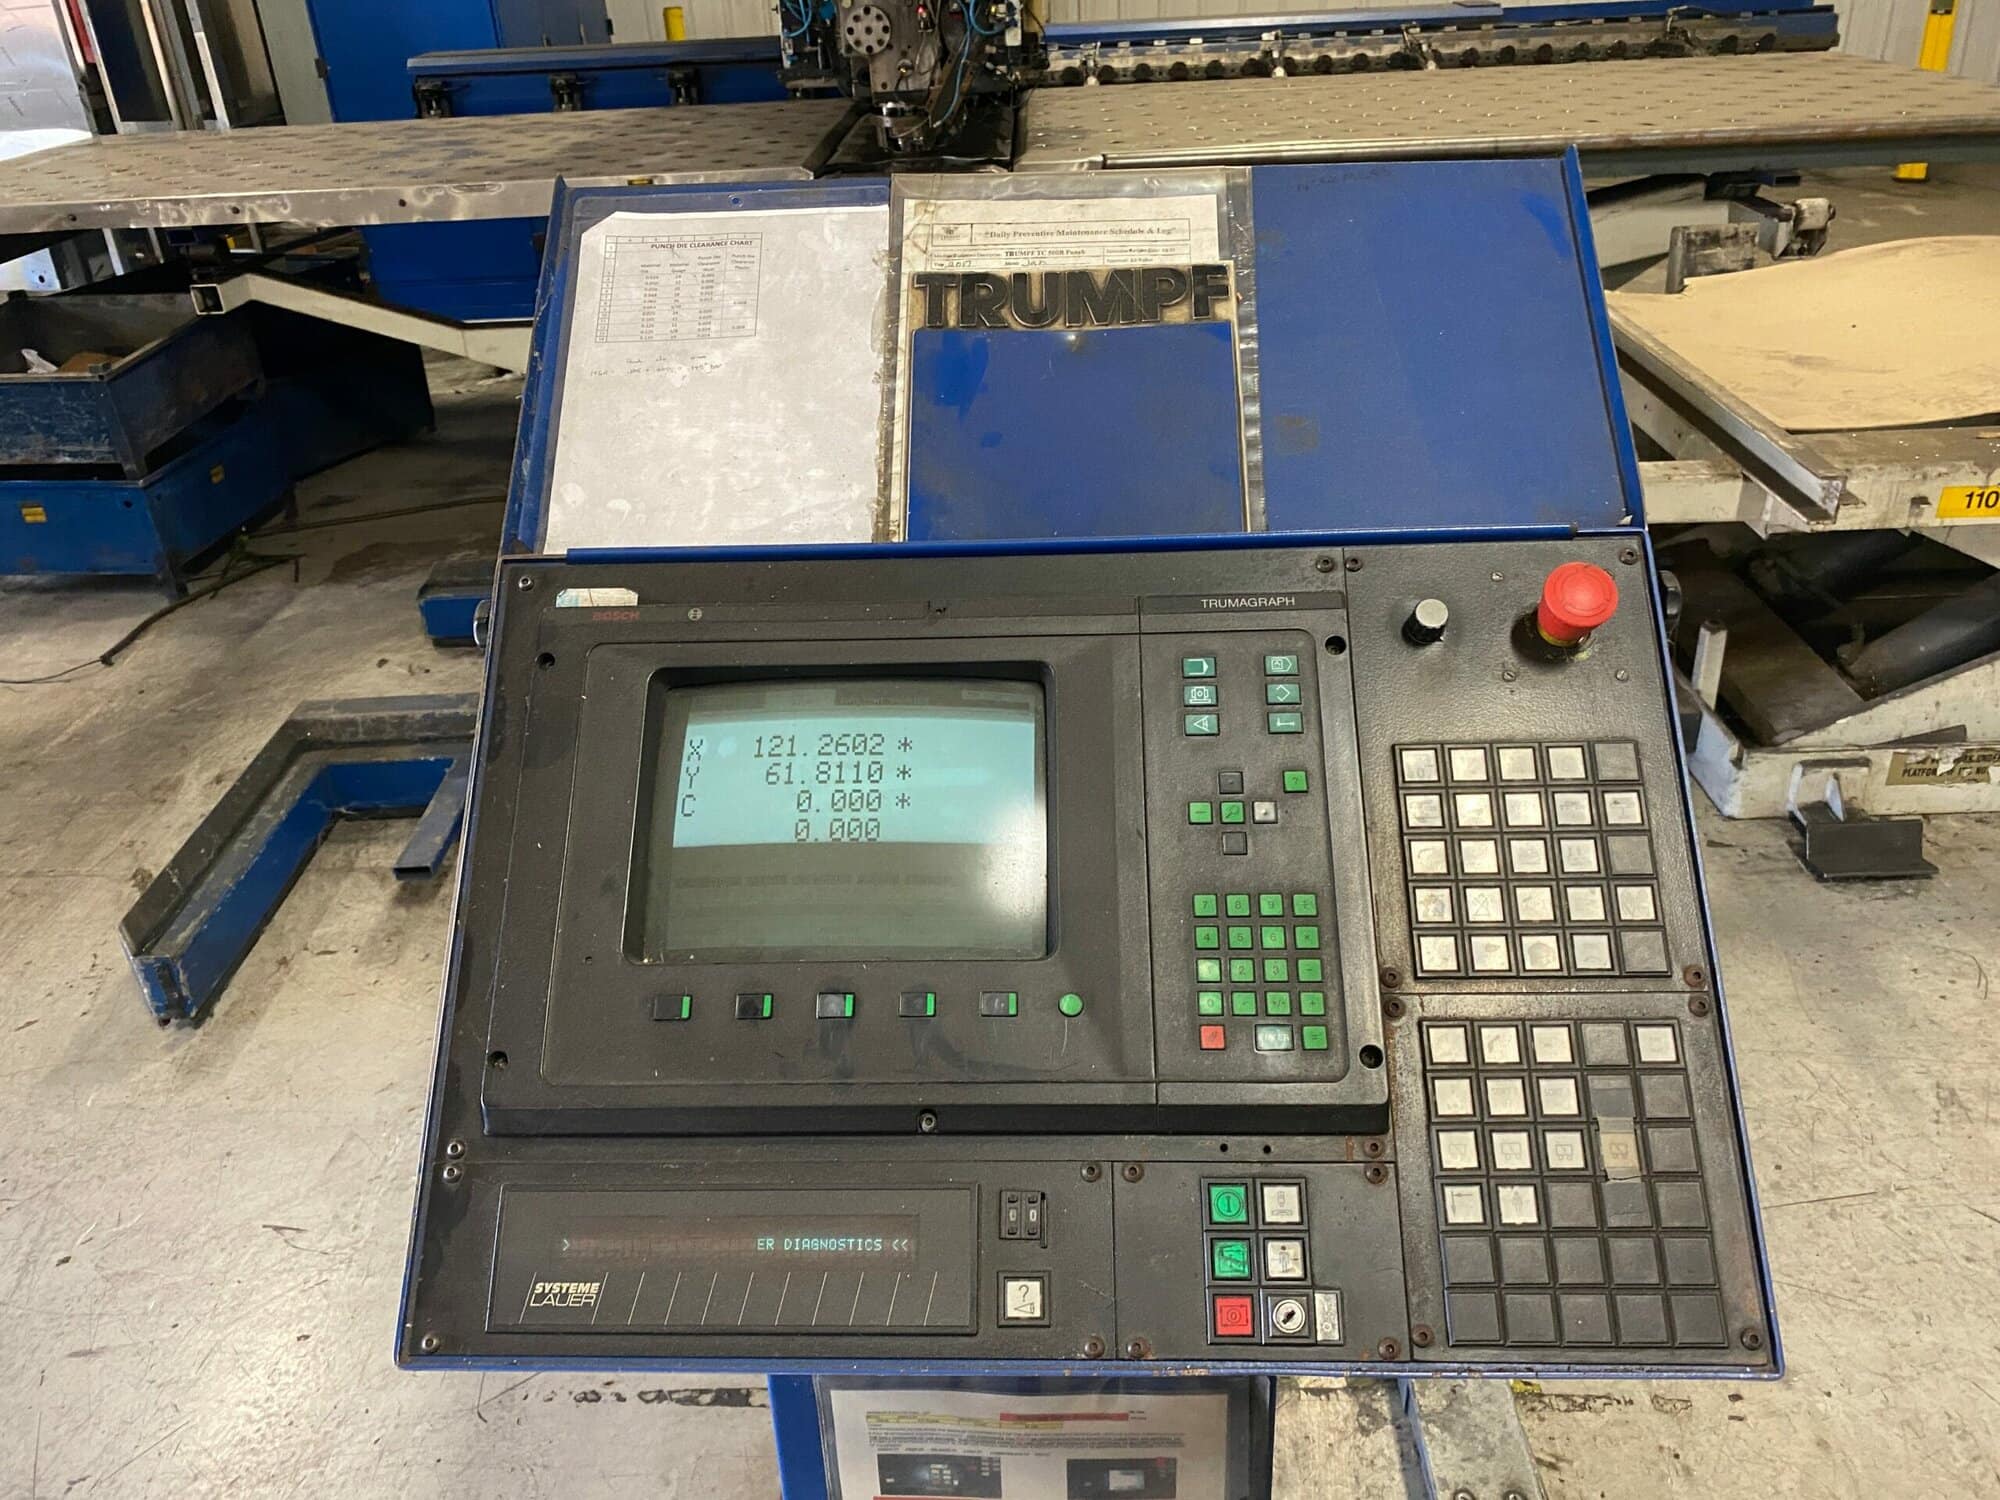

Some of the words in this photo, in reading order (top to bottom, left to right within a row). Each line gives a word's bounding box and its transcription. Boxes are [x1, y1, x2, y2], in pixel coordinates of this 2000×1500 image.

[1013, 230, 1054, 238] Preventive
[1109, 227, 1144, 235] Schedule
[651, 241, 675, 249] PUNCH
[689, 240, 728, 248] CLEARANCE
[913, 264, 1231, 329] TRUMPF
[1201, 596, 1296, 609] TRUMAGRAPH
[687, 738, 704, 762] X
[753, 733, 886, 759] 121.2602
[685, 765, 700, 789] Y
[765, 761, 883, 786] 61.8110
[681, 793, 696, 817] C
[796, 789, 883, 814] 0.000
[794, 818, 881, 841] 0.000
[783, 1238, 882, 1251] DIAGNOSTICS
[534, 1282, 600, 1294] SYSTEME
[529, 1293, 597, 1307] LAUER
